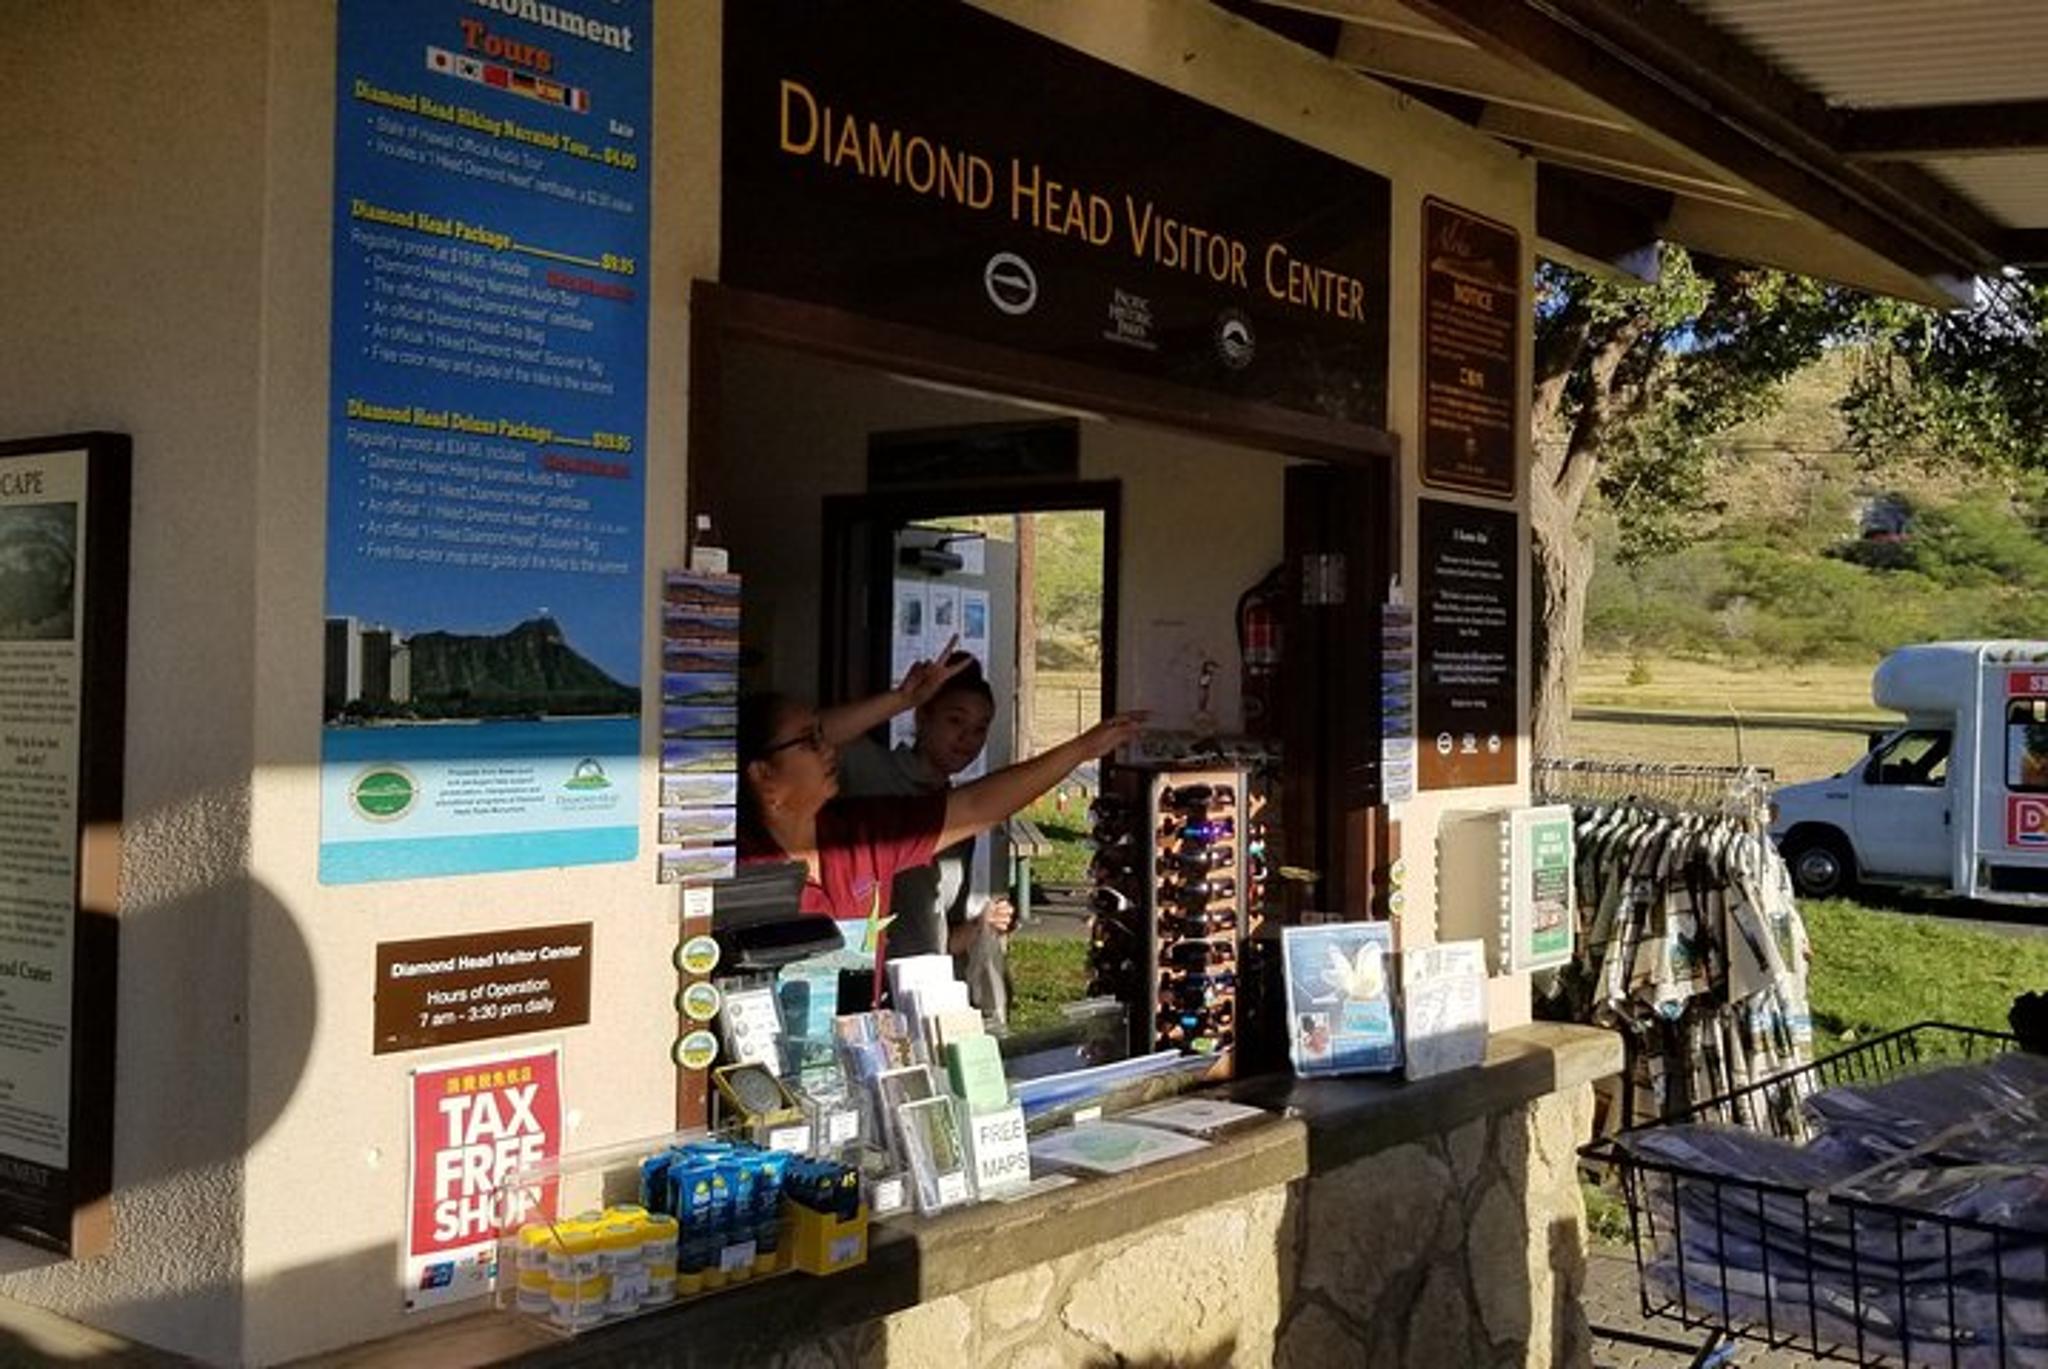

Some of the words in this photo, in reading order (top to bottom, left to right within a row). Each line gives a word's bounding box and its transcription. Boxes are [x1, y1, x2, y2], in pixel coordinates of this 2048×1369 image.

[461, 18, 554, 72] Tours
[470, 0, 633, 51] onument
[354, 79, 418, 112] Diamond
[419, 96, 455, 122] Head
[456, 107, 502, 139] Hiking
[780, 78, 994, 210] DIAMOND
[1012, 158, 1113, 246] HEAD
[1126, 194, 1248, 289] VISITOR
[1265, 243, 1365, 322] CENTER
[351, 199, 416, 229] Diamond
[418, 212, 452, 236] Head
[455, 219, 512, 254] Package
[347, 398, 412, 423] Diamond
[413, 407, 450, 428] Head
[499, 418, 551, 445] Package
[0, 470, 43, 497] CAPE
[390, 957, 454, 979] Diamond
[458, 952, 494, 970] Head
[496, 949, 537, 966] Visitor
[539, 944, 583, 960] Center
[418, 1012, 429, 1028] 7
[431, 1011, 457, 1026] am
[500, 1001, 523, 1018] pm
[525, 997, 556, 1014] daily
[427, 989, 468, 1005] Hours
[470, 985, 485, 999] of
[487, 978, 551, 1000] Operation
[438, 1083, 542, 1149] TAX
[980, 1119, 1022, 1145] FREE
[435, 1133, 547, 1202] FREE
[983, 1151, 1029, 1178] MAPS
[432, 1185, 543, 1242] SHOP
